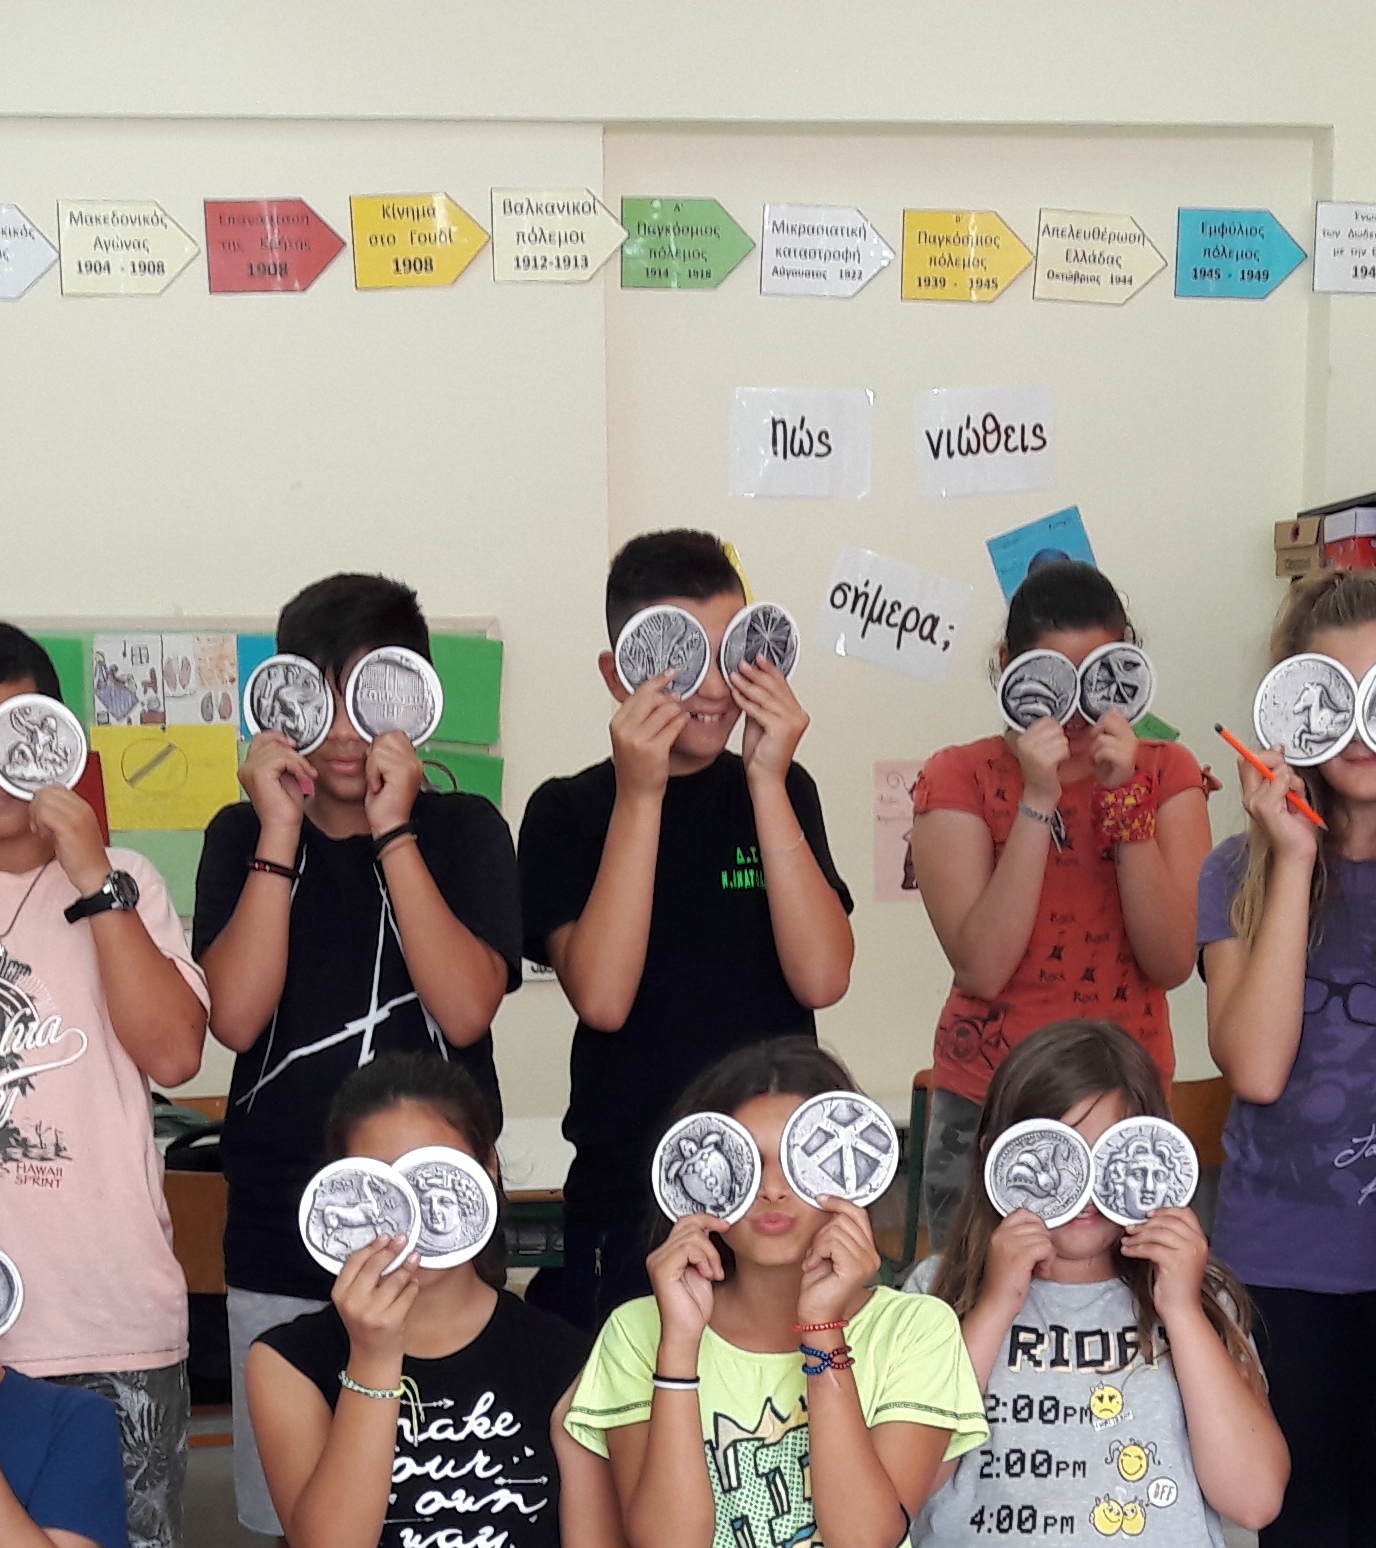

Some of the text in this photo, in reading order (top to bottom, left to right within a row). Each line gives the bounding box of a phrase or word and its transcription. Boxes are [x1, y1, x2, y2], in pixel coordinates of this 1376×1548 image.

[381, 202, 438, 222] Κίνημα
[502, 197, 599, 218] Βαλκανικοί
[69, 209, 168, 230] Μακεδονικός
[515, 227, 587, 249] πόλεμοι
[636, 221, 721, 239] Παγκόσμιος
[1041, 223, 1146, 247] Απελευθέρωση
[1201, 220, 1265, 240] Εμφύλιος
[93, 235, 151, 254] Αγώνας
[368, 232, 396, 248] στο
[917, 231, 1001, 250] Παγκόσμιος
[513, 253, 589, 271] 1912-1913
[648, 247, 708, 263] πόλεμος
[928, 254, 987, 271] πόλεμος
[1065, 247, 1123, 269] Ελλάδας
[1202, 245, 1260, 263] πόλεμος
[76, 259, 112, 276] 1904
[129, 259, 166, 276] 1908
[247, 262, 289, 278] 1908
[392, 256, 434, 276] 1908
[1192, 267, 1221, 281] 1945
[1239, 268, 1270, 283] 1949
[916, 275, 947, 289] 1939
[968, 276, 999, 290] 1945
[771, 411, 1047, 461] Πώς νιώθεις
[829, 579, 956, 652] σήμερα;
[15, 1162, 63, 1177] HAWAII
[14, 1174, 63, 1189] SPRINT
[415, 1488, 548, 1515] own
